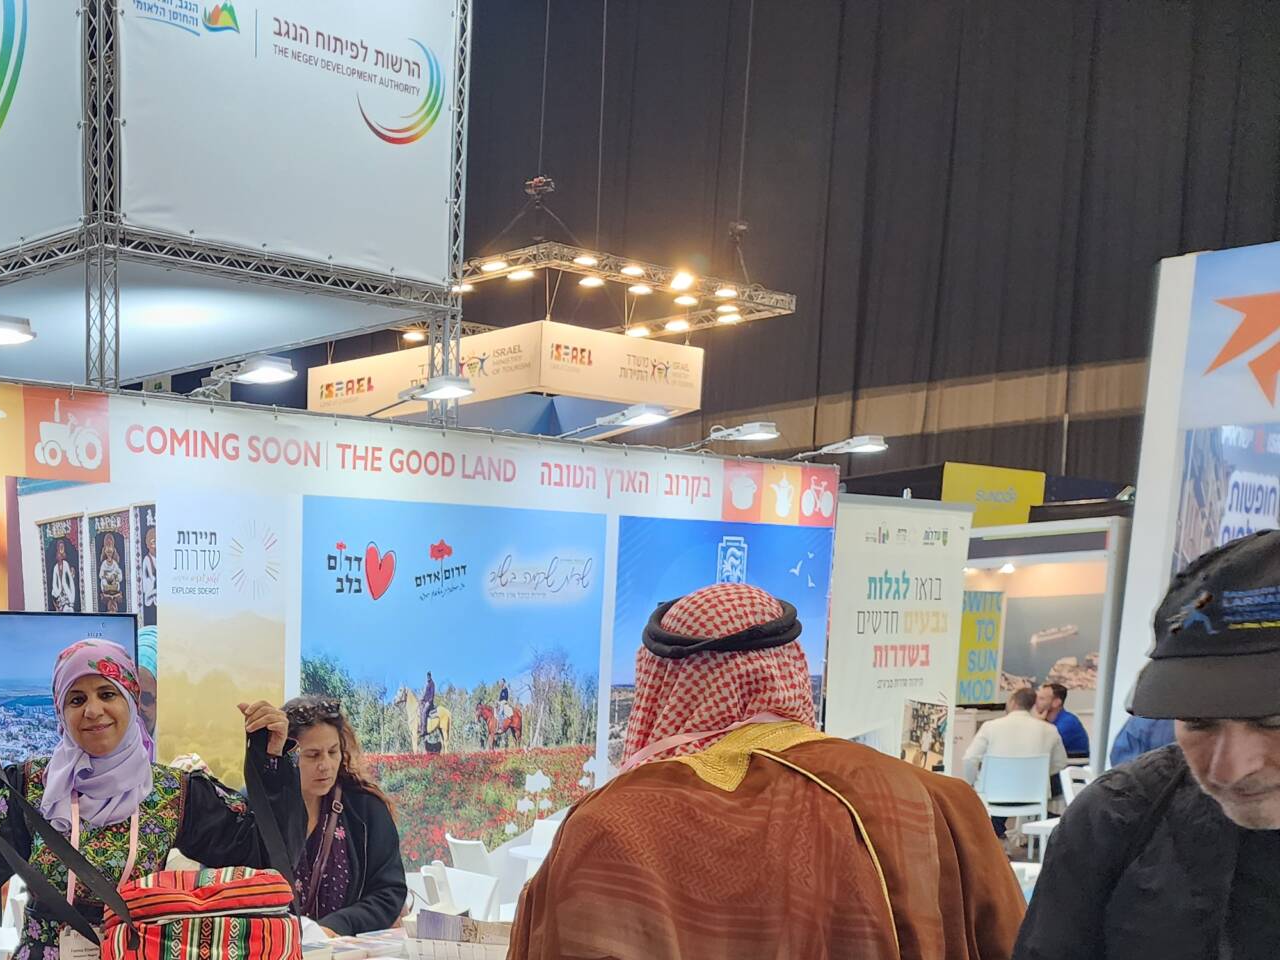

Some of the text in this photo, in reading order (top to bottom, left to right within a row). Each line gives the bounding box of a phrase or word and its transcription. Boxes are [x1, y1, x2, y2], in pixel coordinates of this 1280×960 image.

[273, 17, 421, 79] הרשות לפיתוח הנגב
[273, 44, 421, 97] THE NEGEV DEVELOPMENT AUTHORITY
[125, 423, 517, 483] COMING SOON THE GOOD LAND
[540, 461, 711, 504] בקרוב הארץ הטובה
[177, 530, 217, 545] תיירות
[173, 549, 221, 571] שדרות
[336, 574, 362, 594] בלב
[415, 565, 467, 587] דרום אדום
[867, 569, 942, 600] בואו לגלות
[856, 610, 899, 635] חדשים
[975, 620, 995, 642] TO
[872, 644, 930, 668] בשדרות
[968, 649, 997, 672] SUN
